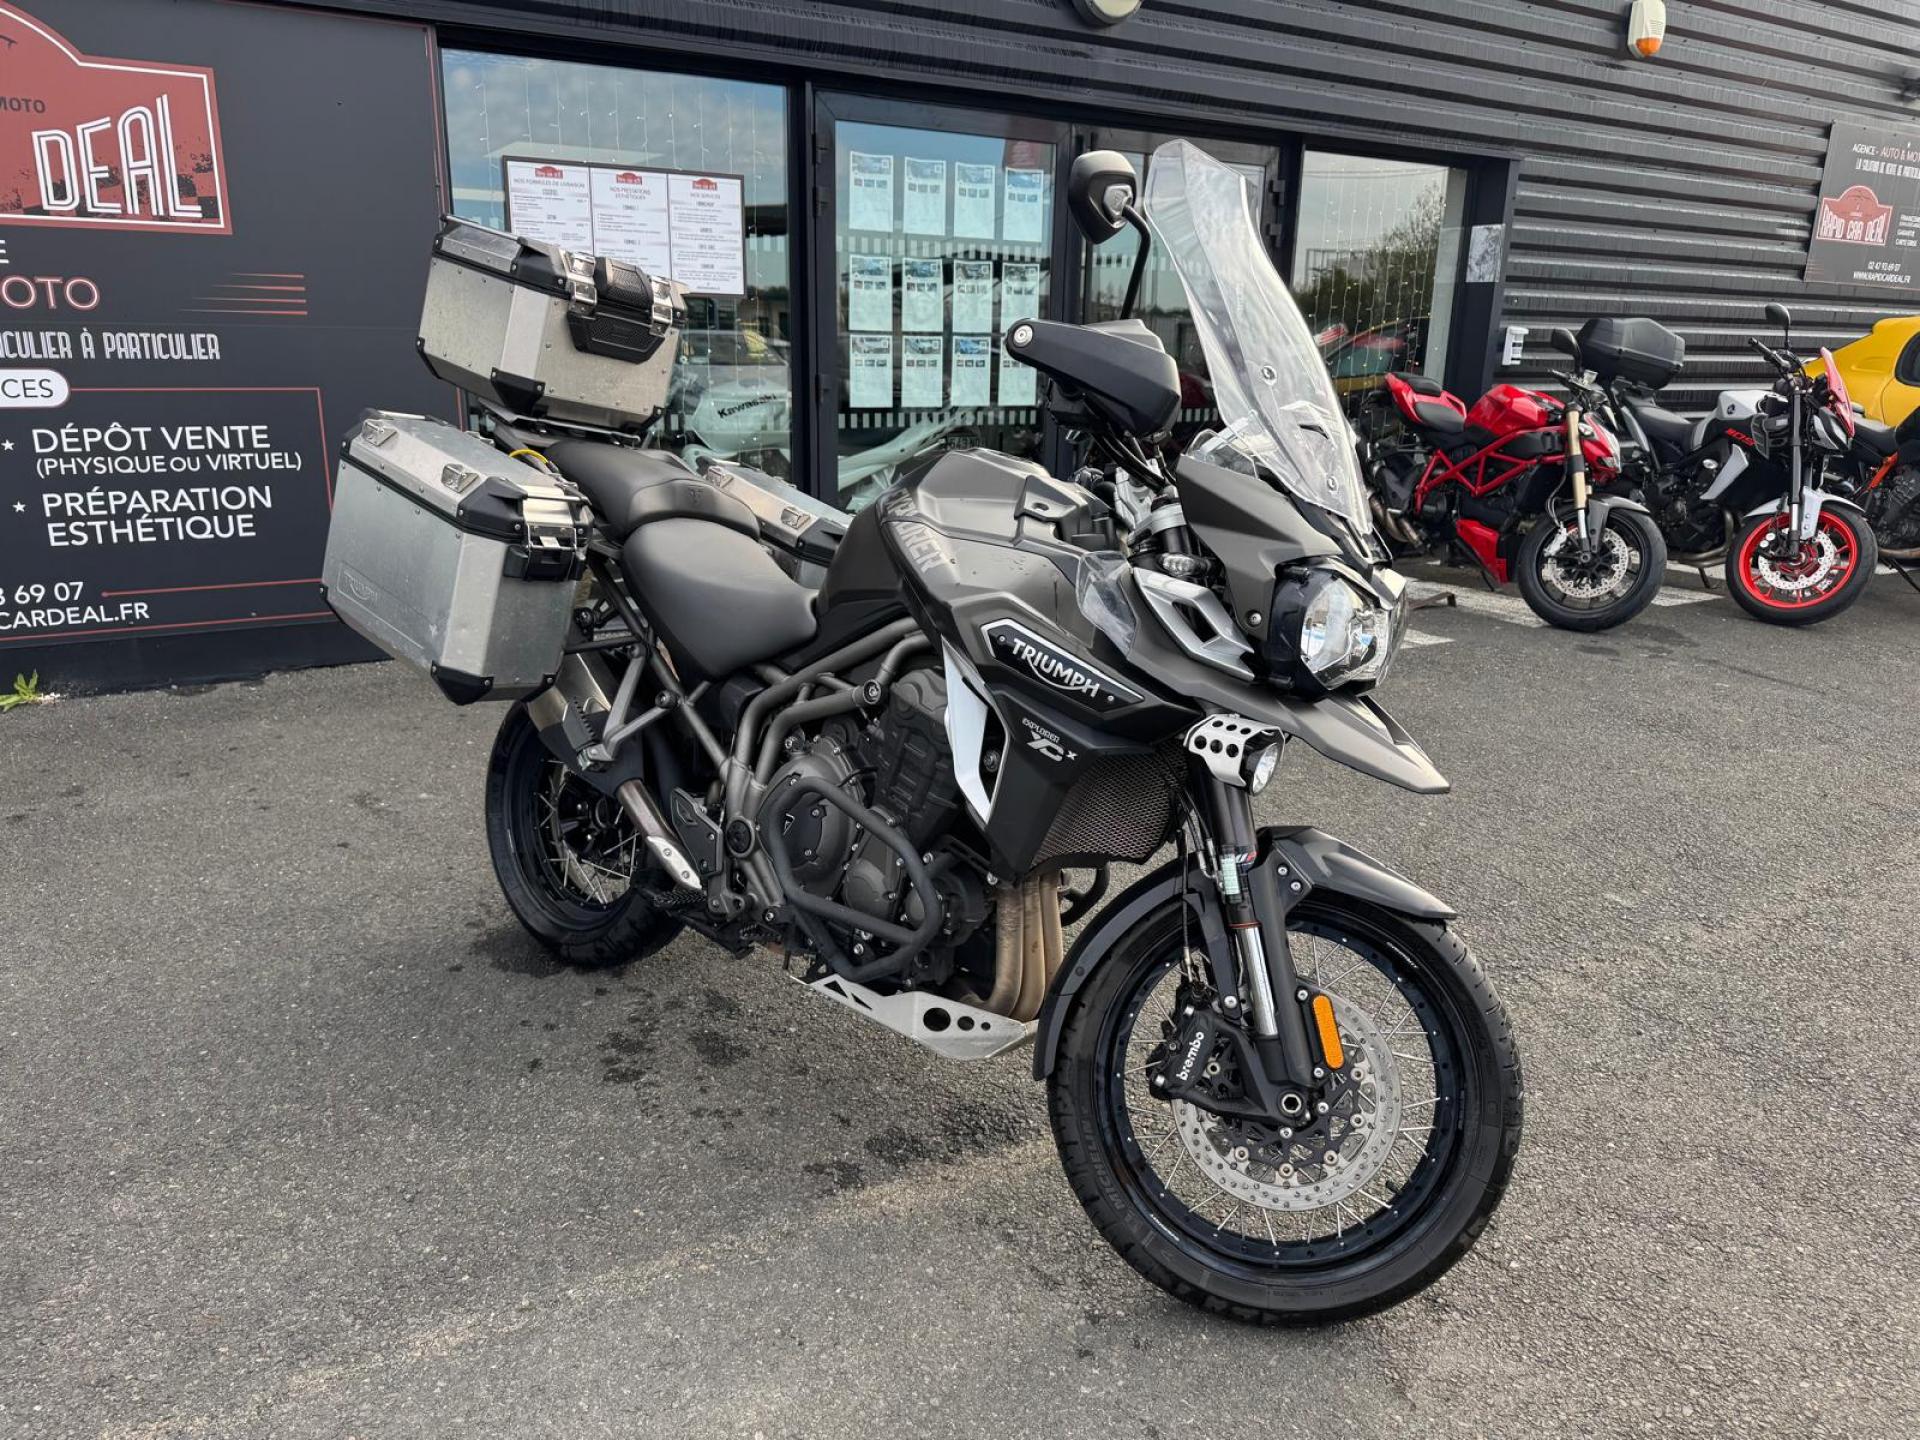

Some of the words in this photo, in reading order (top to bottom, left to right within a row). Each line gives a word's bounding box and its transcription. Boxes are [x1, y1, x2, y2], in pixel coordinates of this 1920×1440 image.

[32, 94, 203, 218] DEAL
[1, 275, 99, 310] OTO
[80, 327, 95, 359] À
[102, 331, 220, 360] PARTICULIER
[1, 378, 54, 398] CES
[32, 422, 152, 453] DÉPÔT
[160, 425, 271, 450] VENTE
[36, 455, 167, 479] (PHYSIQUE
[169, 456, 201, 472] OU
[205, 452, 302, 472] VIRTUEL)
[42, 485, 273, 517] PRÉPARATION
[48, 513, 257, 547] ESTHÉTIQUE
[14, 584, 46, 604] 69
[53, 581, 84, 601] 07
[0, 602, 150, 630] CARDEAL.FR
[1012, 637, 1100, 698] TRIUMPH
[1022, 717, 1061, 744] EXPLORER
[1175, 1031, 1205, 1081] brembo
